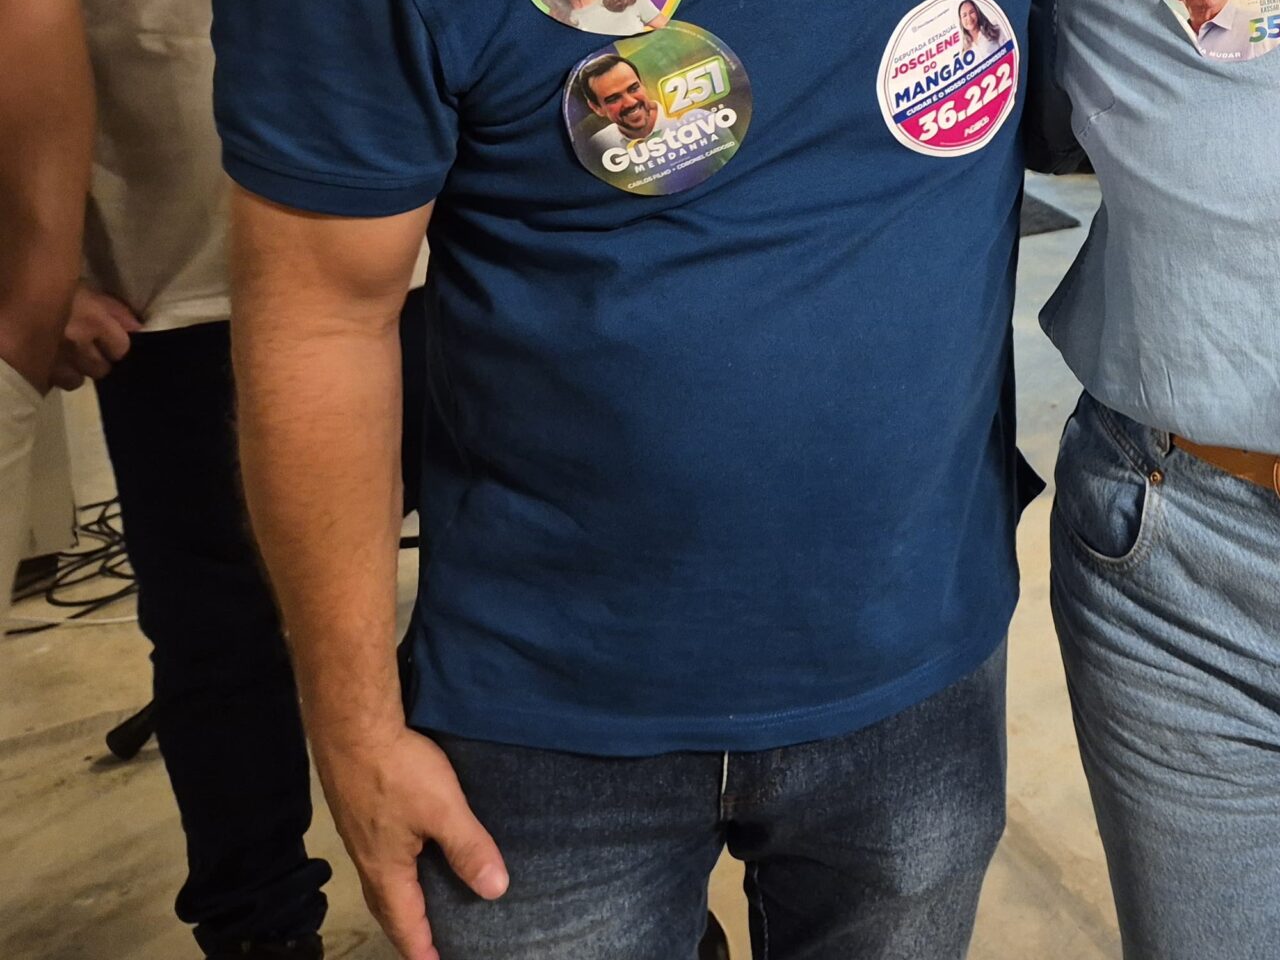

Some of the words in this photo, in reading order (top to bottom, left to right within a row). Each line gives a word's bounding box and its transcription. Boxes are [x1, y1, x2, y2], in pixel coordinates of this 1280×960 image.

[892, 31, 961, 79] JOSCILENE
[894, 43, 927, 64] DEPUTADA
[927, 23, 957, 45] ESTADUAL
[923, 61, 937, 74] DO
[664, 60, 725, 114] 251
[894, 49, 976, 109] MANGÃO
[906, 99, 932, 117] CUIDAR
[938, 91, 945, 100] O
[945, 78, 966, 95] NOSSO
[917, 63, 1013, 142] 36.222
[601, 107, 738, 173] Gustavo
[634, 133, 719, 174] MENDANHA
[627, 176, 653, 190] CARLOS
[676, 154, 706, 170] CORONEL
[705, 141, 735, 157] CARDOSO
